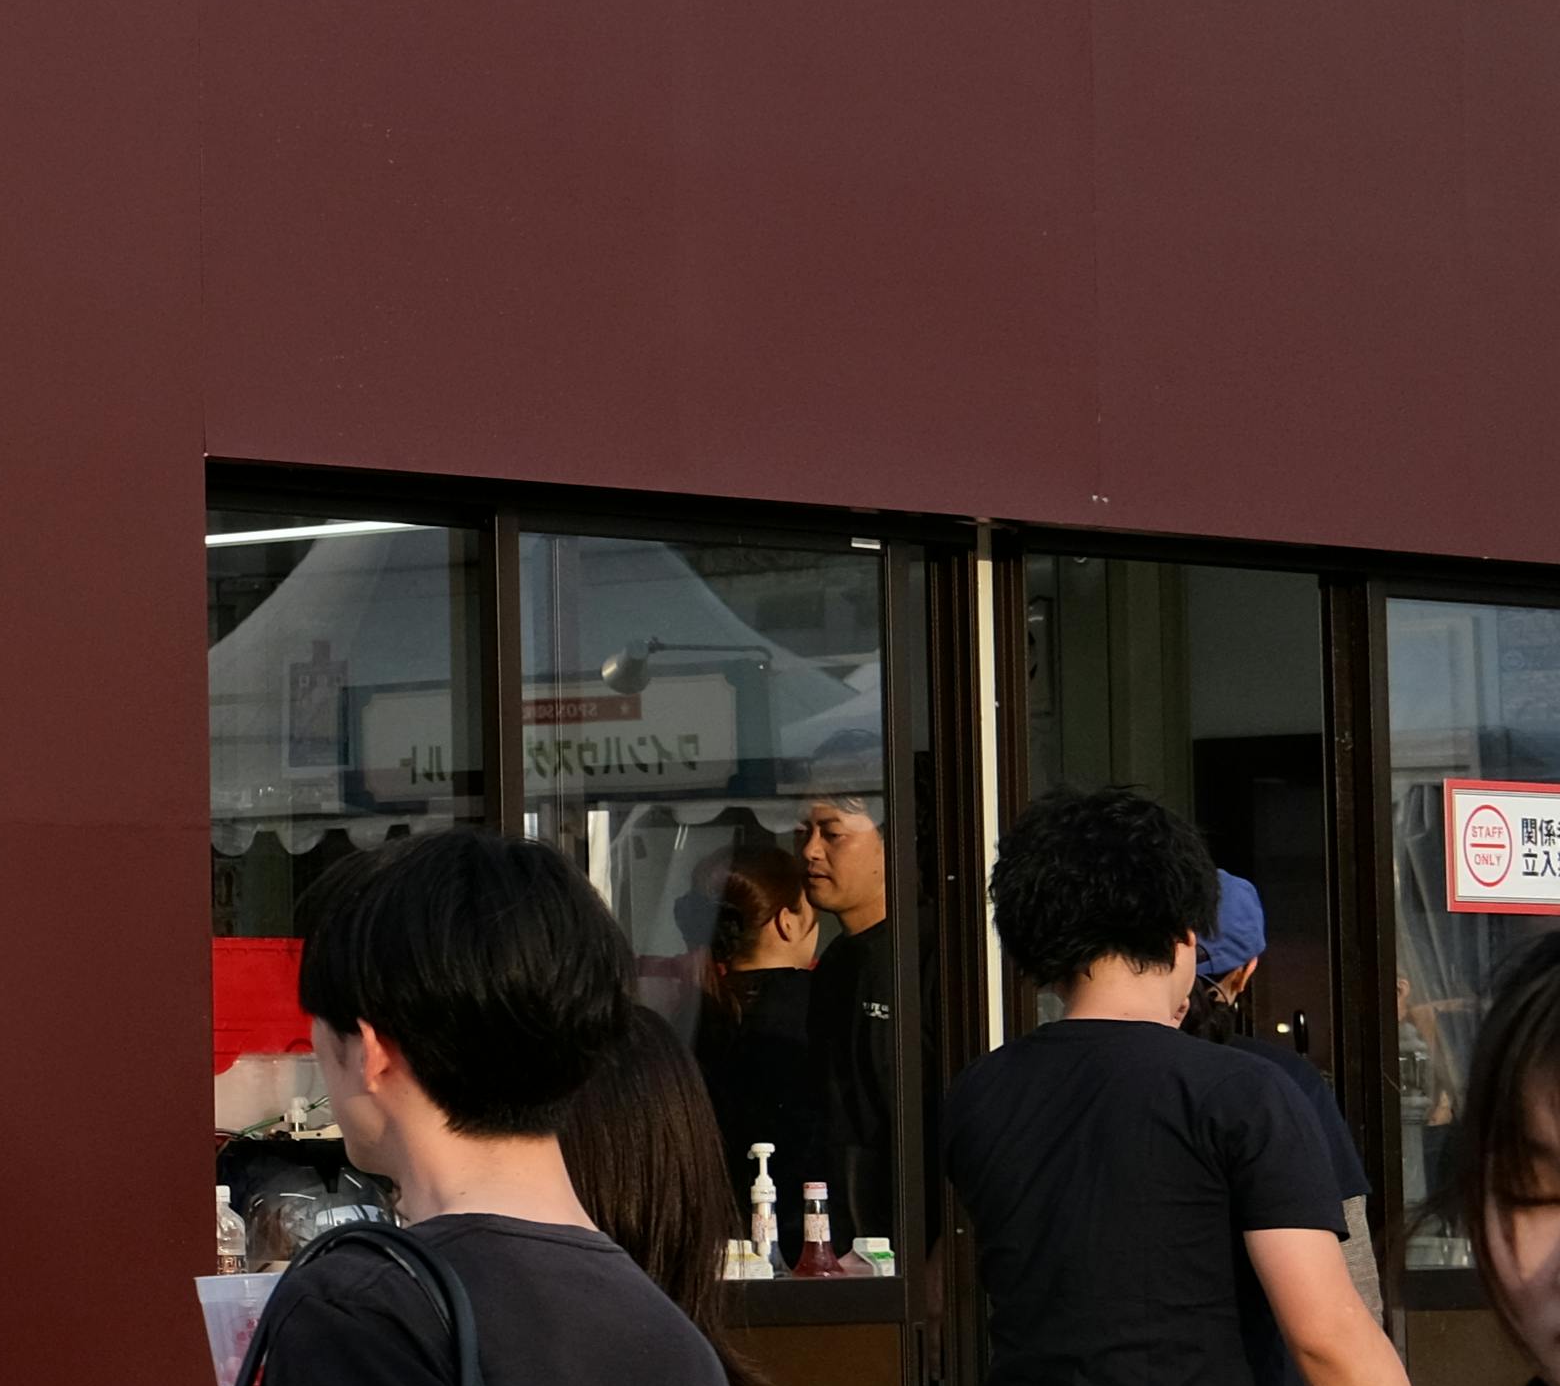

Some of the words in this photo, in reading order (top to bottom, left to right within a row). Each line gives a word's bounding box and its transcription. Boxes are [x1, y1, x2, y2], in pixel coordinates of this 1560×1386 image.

[1471, 825, 1504, 839] STAFF
[1520, 817, 1560, 847] 関係
[1473, 853, 1503, 866] ONLY
[1521, 847, 1560, 878] 立入
